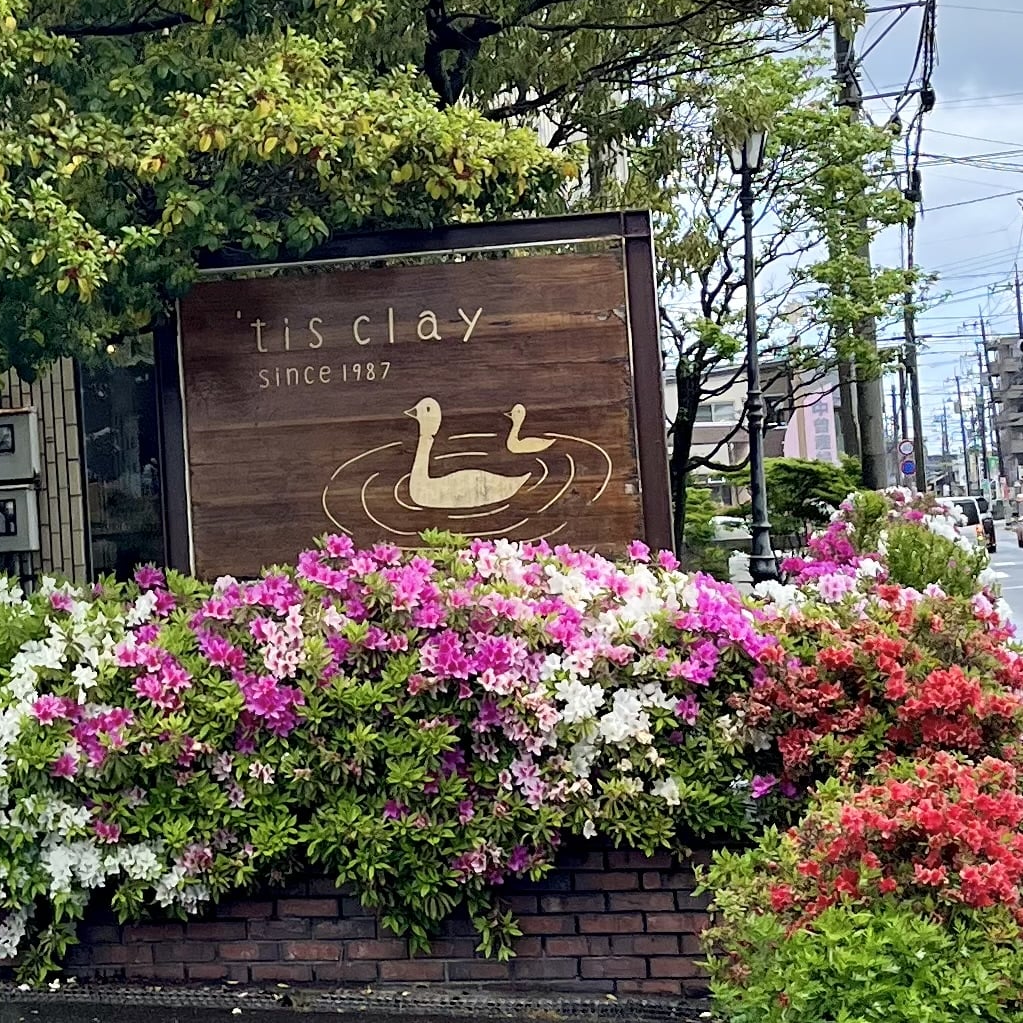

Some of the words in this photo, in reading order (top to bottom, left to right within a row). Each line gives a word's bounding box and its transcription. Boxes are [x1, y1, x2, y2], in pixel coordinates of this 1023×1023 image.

[236, 310, 323, 353] 'tis
[352, 306, 484, 345] clay
[259, 365, 332, 389] since
[341, 361, 392, 382] 1987
